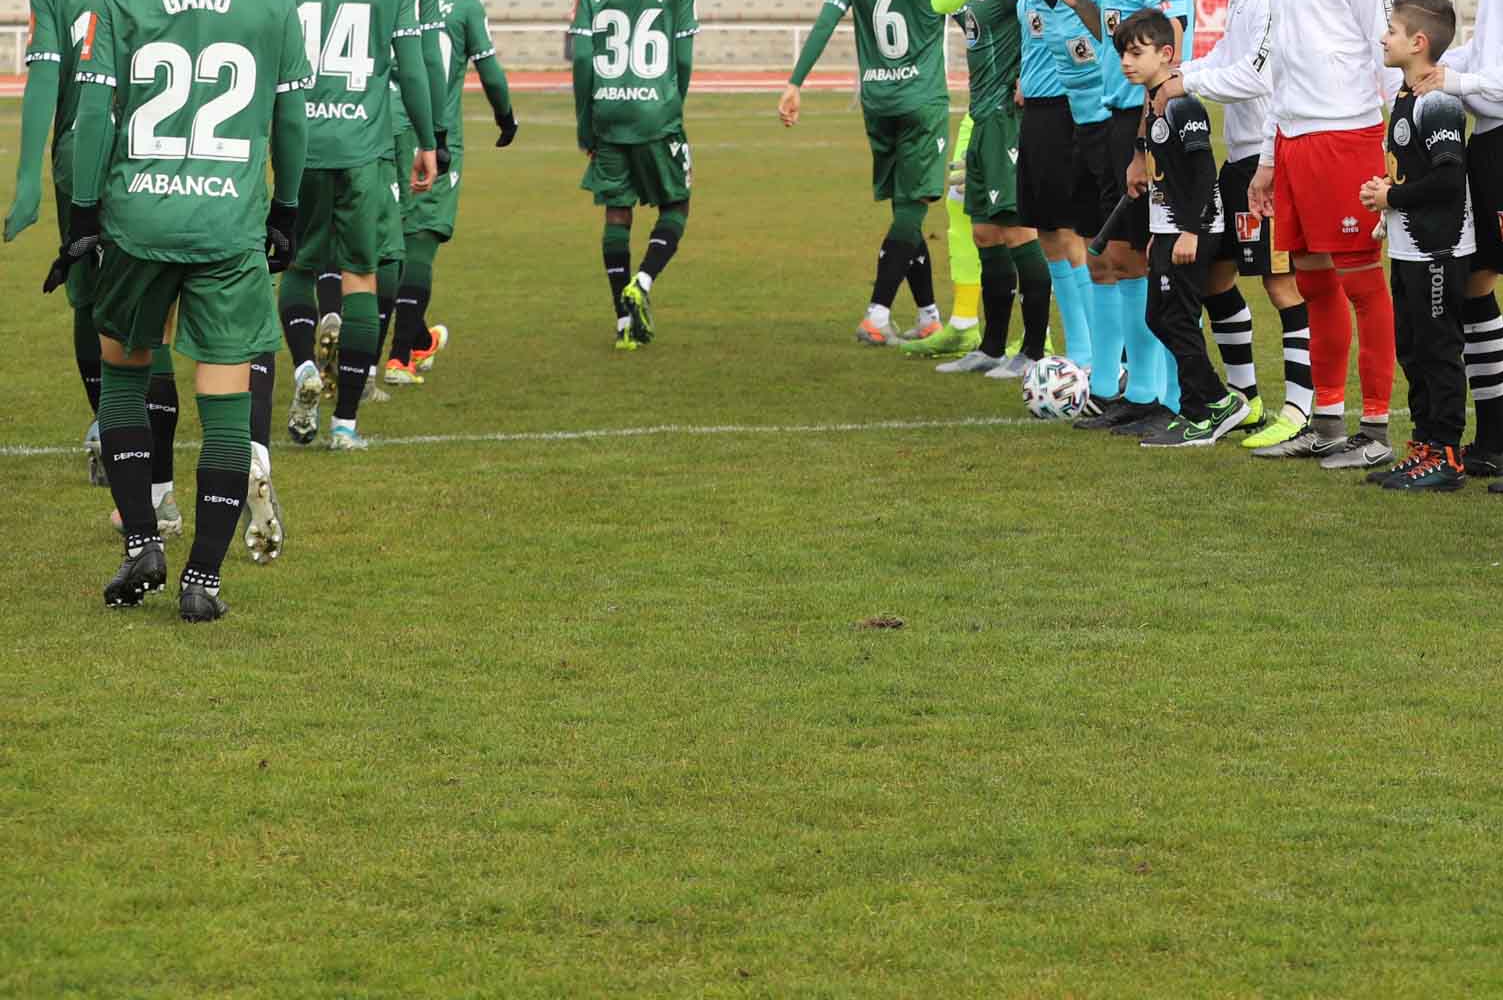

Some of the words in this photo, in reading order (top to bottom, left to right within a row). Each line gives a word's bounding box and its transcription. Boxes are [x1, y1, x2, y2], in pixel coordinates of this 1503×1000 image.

[297, 1, 375, 91] 14
[592, 8, 669, 79] 36
[128, 42, 256, 162] 22
[305, 102, 368, 120] BANCA
[130, 172, 239, 198] ABANCA
[1429, 264, 1444, 319] Joma
[113, 451, 150, 461] DEPOR
[204, 495, 240, 507] DEPOR
